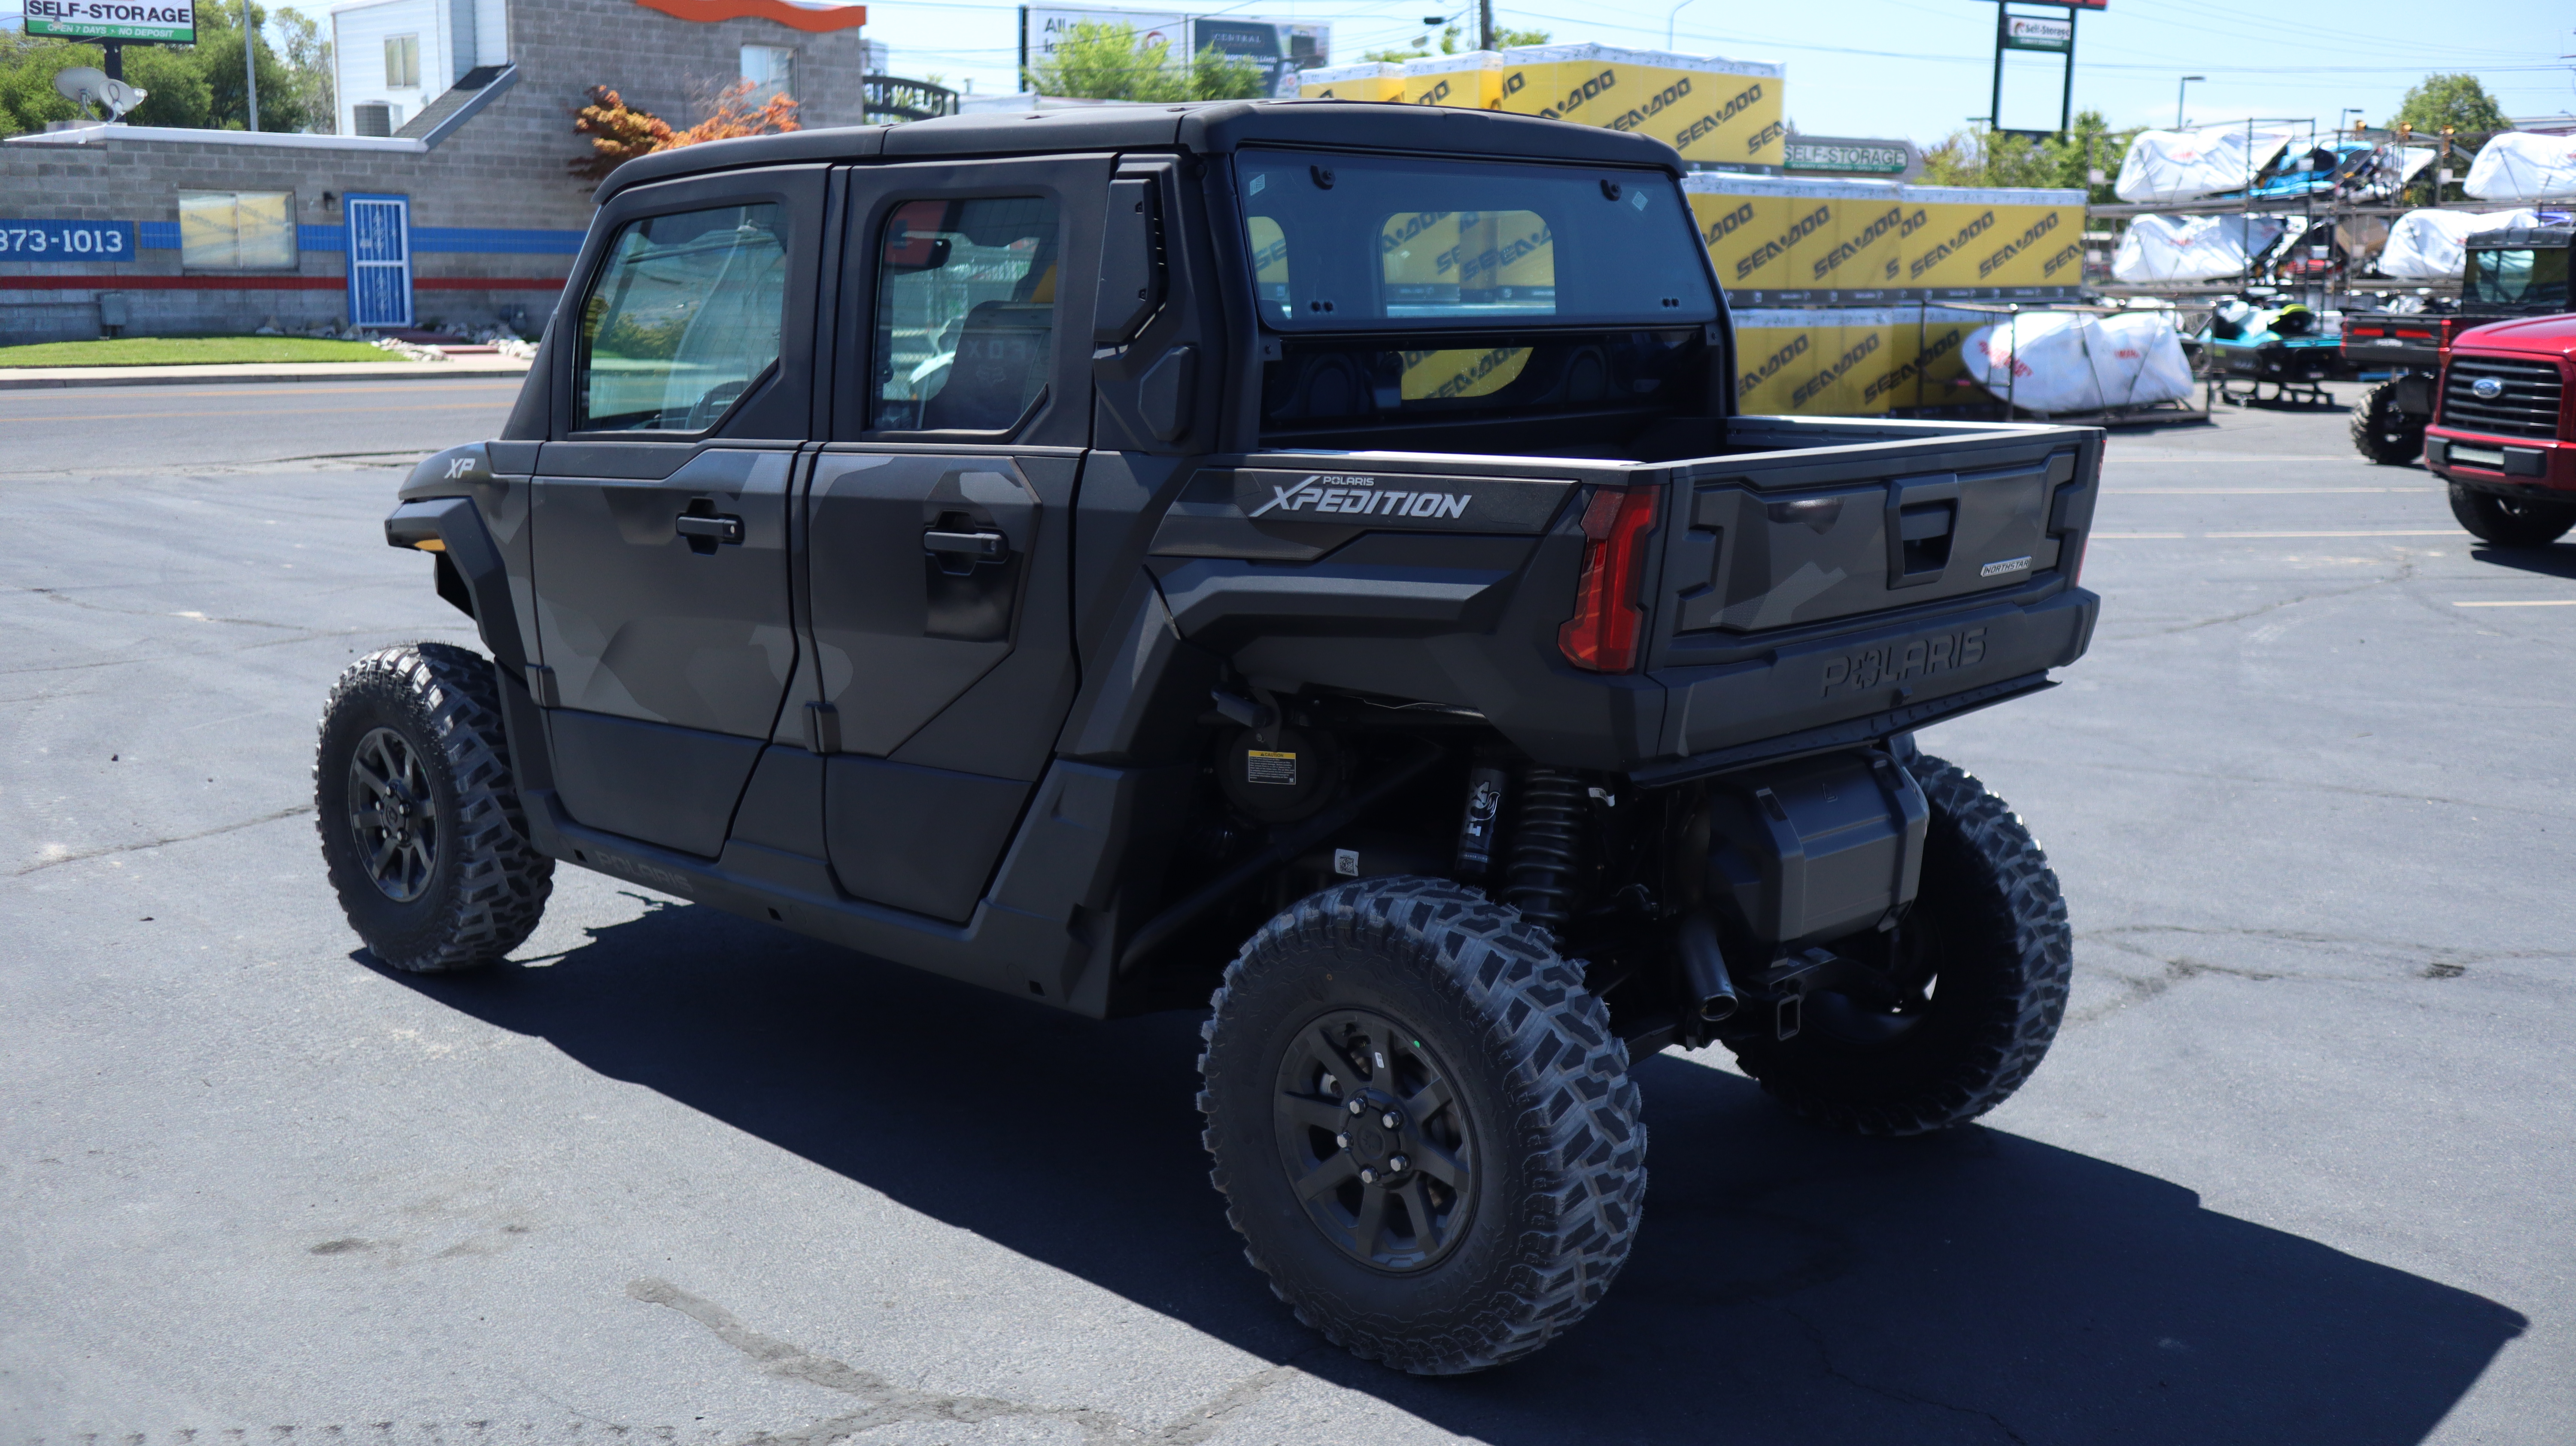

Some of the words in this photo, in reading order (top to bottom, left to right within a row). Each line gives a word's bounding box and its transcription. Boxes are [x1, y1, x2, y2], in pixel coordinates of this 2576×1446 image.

[28, 0, 191, 23] SELF-STORAGE
[47, 24, 74, 32] OPEN
[82, 26, 107, 34] DAYS
[118, 27, 133, 36] NO
[134, 28, 174, 37] DEPOSIT
[1214, 33, 1262, 43] CENTRAL
[1784, 146, 1904, 166] SELF-STORAGE
[444, 458, 476, 479] XP
[1323, 476, 1374, 486] POLARIS
[1249, 476, 1472, 519] XPEDITION
[1985, 559, 2029, 574] NORTHSTAR
[1821, 627, 1988, 698] POLARIS
[594, 850, 695, 893] POLARIS
